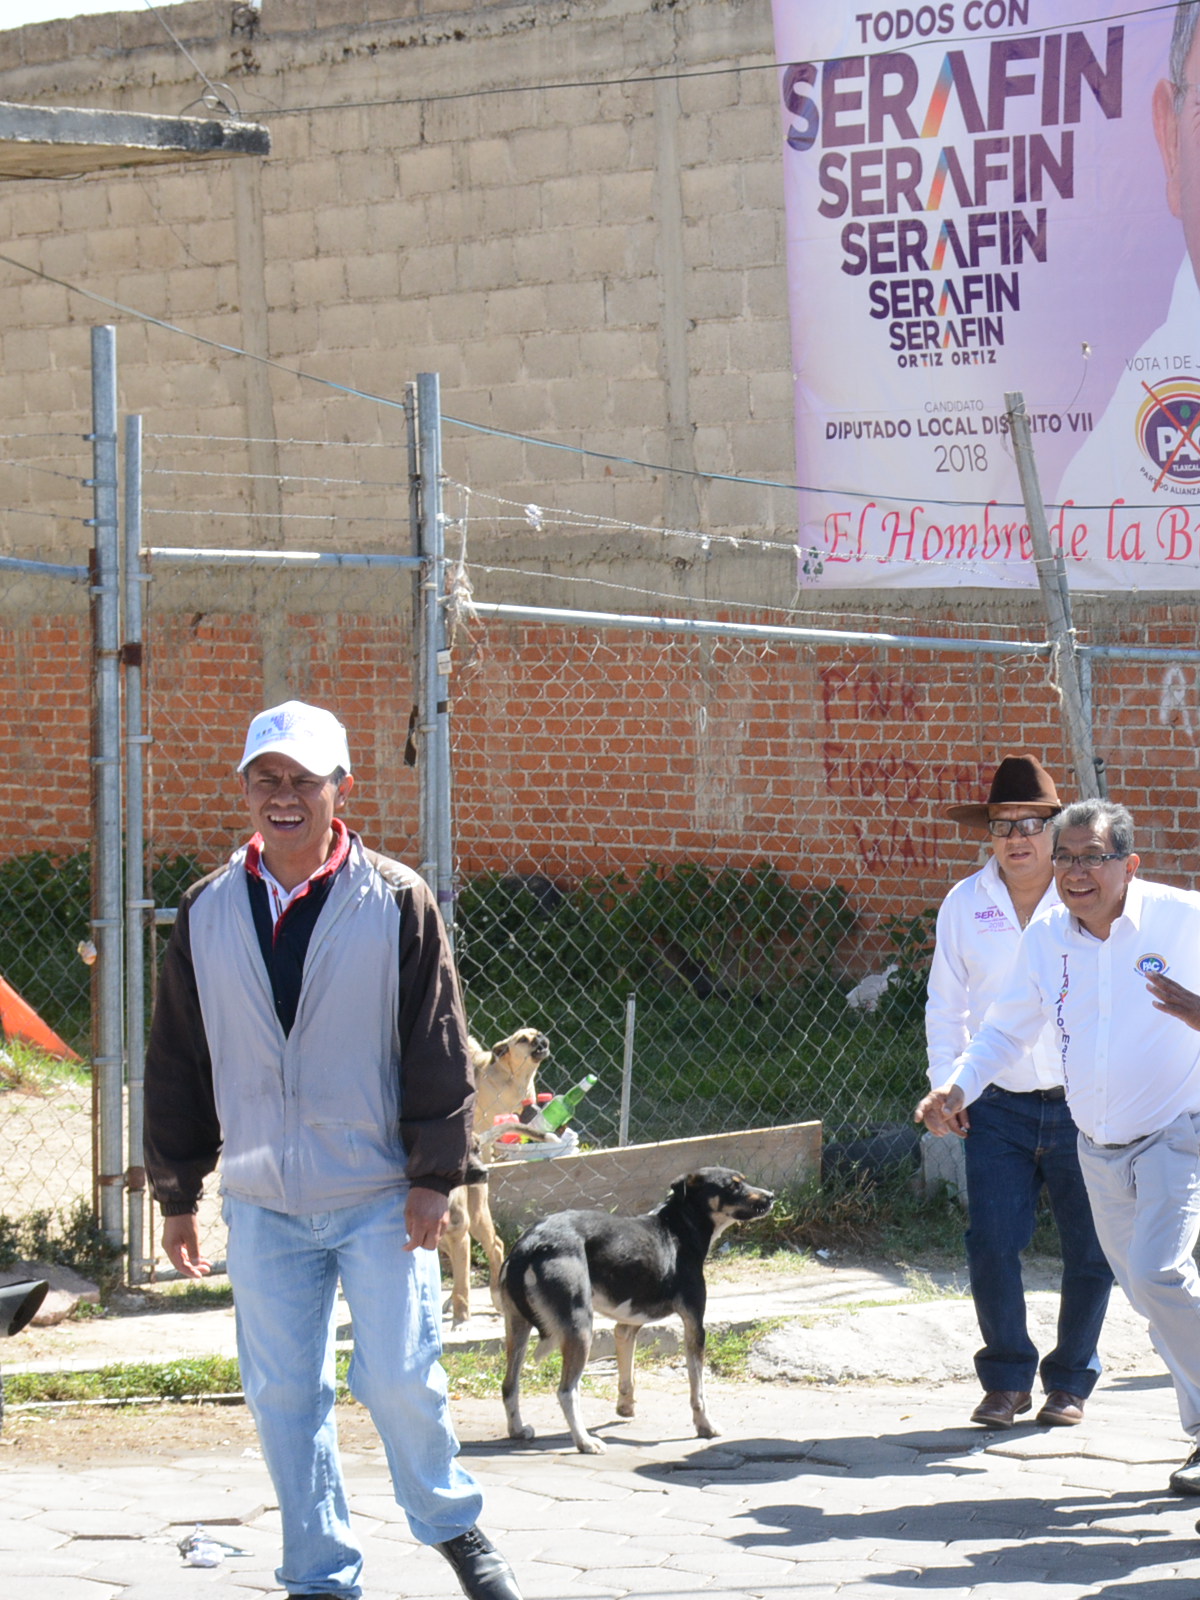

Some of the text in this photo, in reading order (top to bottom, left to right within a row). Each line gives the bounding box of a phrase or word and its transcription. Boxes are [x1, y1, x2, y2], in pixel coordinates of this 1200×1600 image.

[856, 0, 1029, 43] TODOS CON
[783, 25, 1125, 151] SERAFIN
[817, 130, 1074, 218] SERAFIN
[840, 208, 1048, 276] SERAFIN
[868, 271, 1021, 320] SERAFIN
[889, 315, 1005, 352] SERAFIN
[897, 349, 997, 369] ORTIZ ORTIZ
[1125, 356, 1161, 372] VOTA
[1164, 356, 1170, 371] 1
[1173, 355, 1192, 370] DE
[924, 399, 985, 414] CANDIDATO
[825, 411, 1095, 440] DIPUTADO LOCAL DISITO VII
[935, 443, 989, 473] 2018
[1140, 466, 1170, 492] PARTDO
[824, 502, 876, 563] El
[880, 500, 1034, 565] Hombre
[1048, 499, 1089, 563] de
[1106, 498, 1153, 562] la
